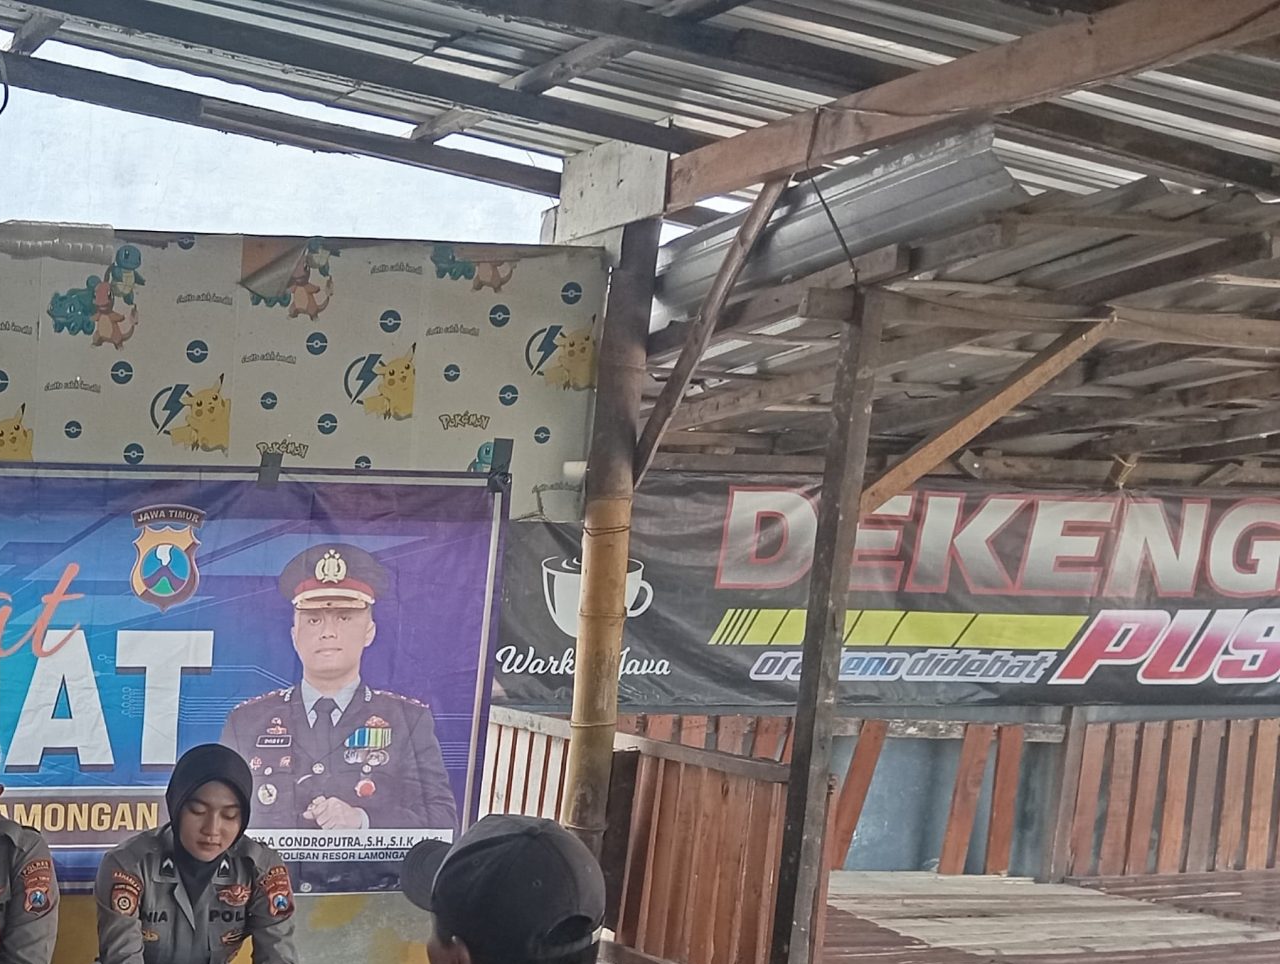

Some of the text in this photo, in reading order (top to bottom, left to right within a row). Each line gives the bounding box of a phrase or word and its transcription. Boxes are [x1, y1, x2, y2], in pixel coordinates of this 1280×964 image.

[137, 509, 200, 523] JAWA TIMUR
[715, 486, 1280, 598] DEKENG
[322, 851, 355, 860] RESOR
